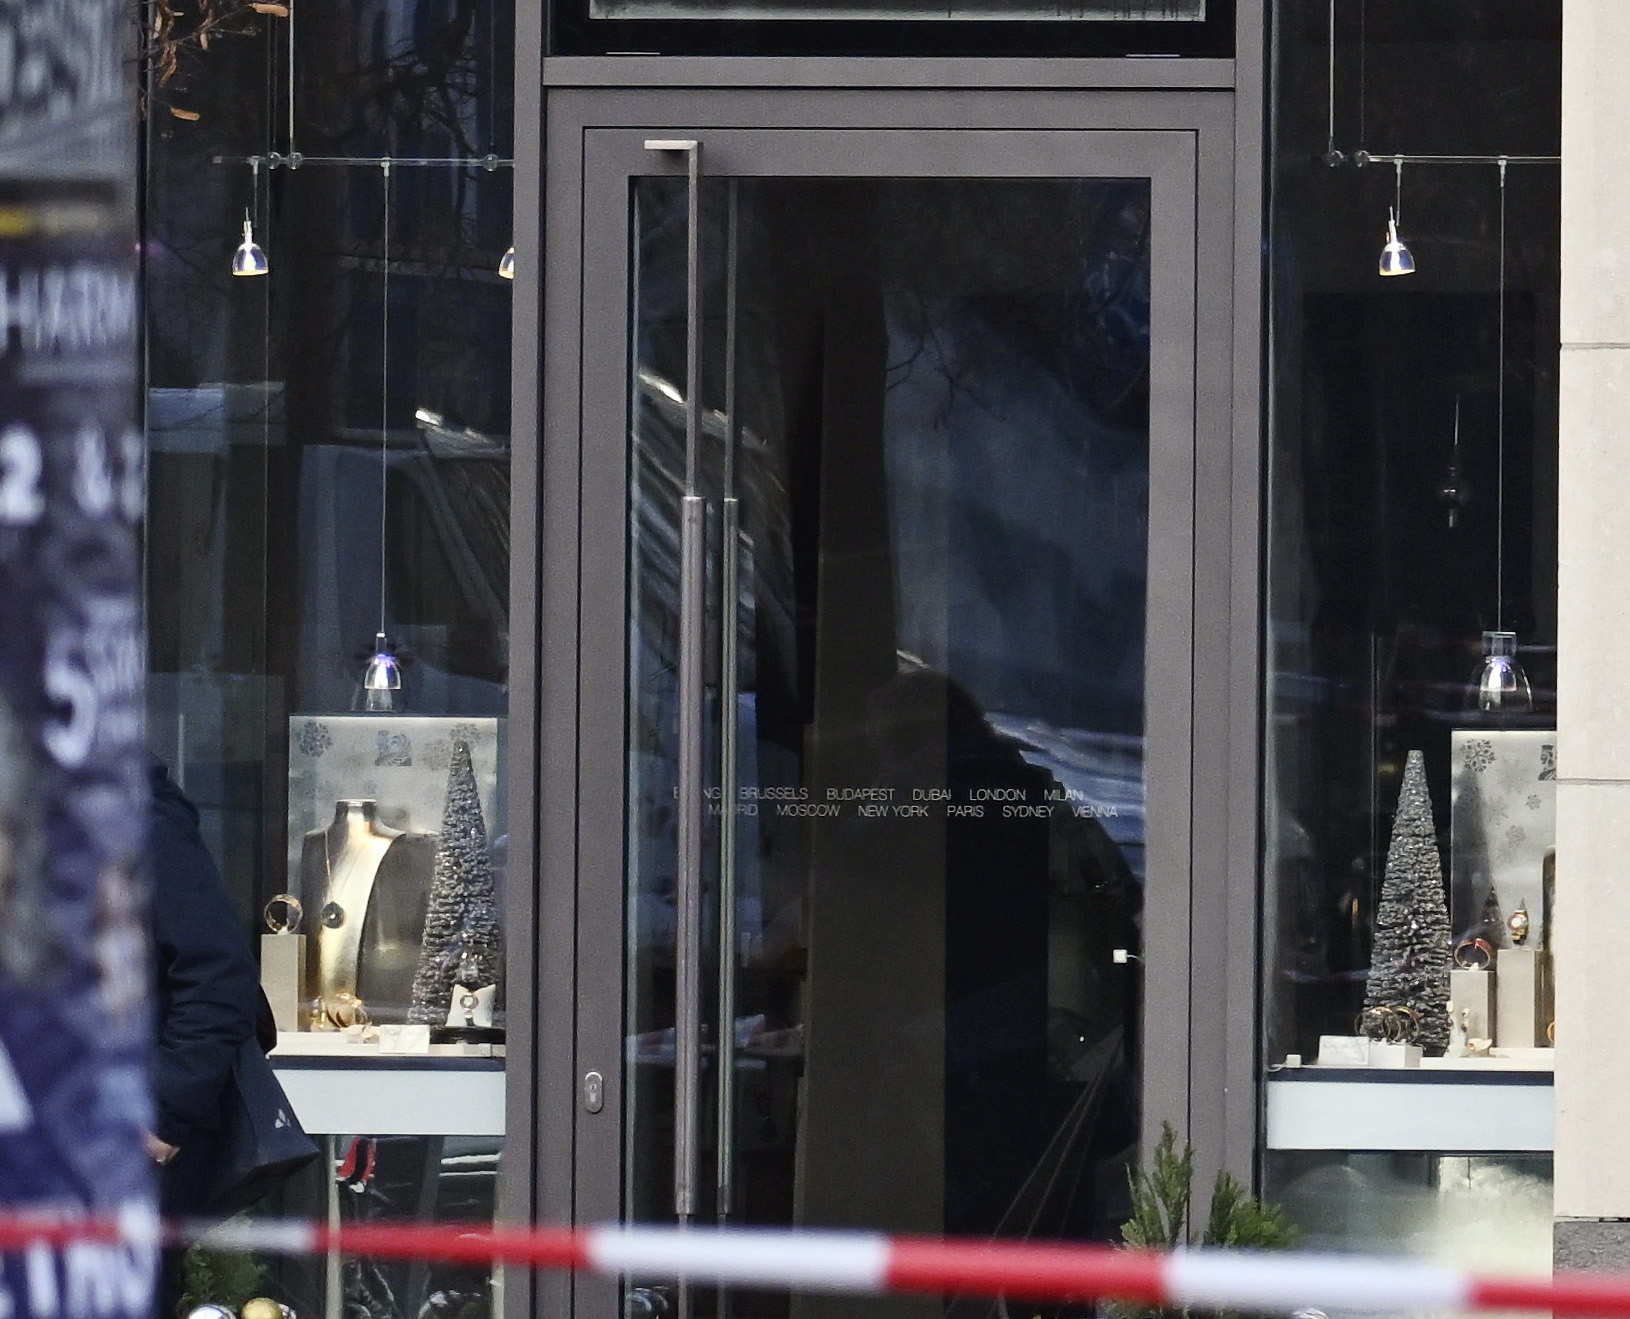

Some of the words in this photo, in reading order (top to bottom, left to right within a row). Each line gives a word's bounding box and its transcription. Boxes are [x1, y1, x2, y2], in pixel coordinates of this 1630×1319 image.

[740, 787, 808, 800] BRUSSELS
[827, 788, 895, 801] BUDAPEST
[912, 788, 951, 801] DUBAI
[969, 788, 1026, 801] LONDON
[1044, 788, 1084, 801] MILAN
[709, 804, 759, 817] MARID
[776, 804, 841, 817] MOSCOW
[858, 805, 889, 818] NEW
[893, 805, 929, 818] YORK
[947, 805, 984, 818] PARIS
[1003, 805, 1054, 818] SYDNEY
[1072, 805, 1119, 818] VIENNA
